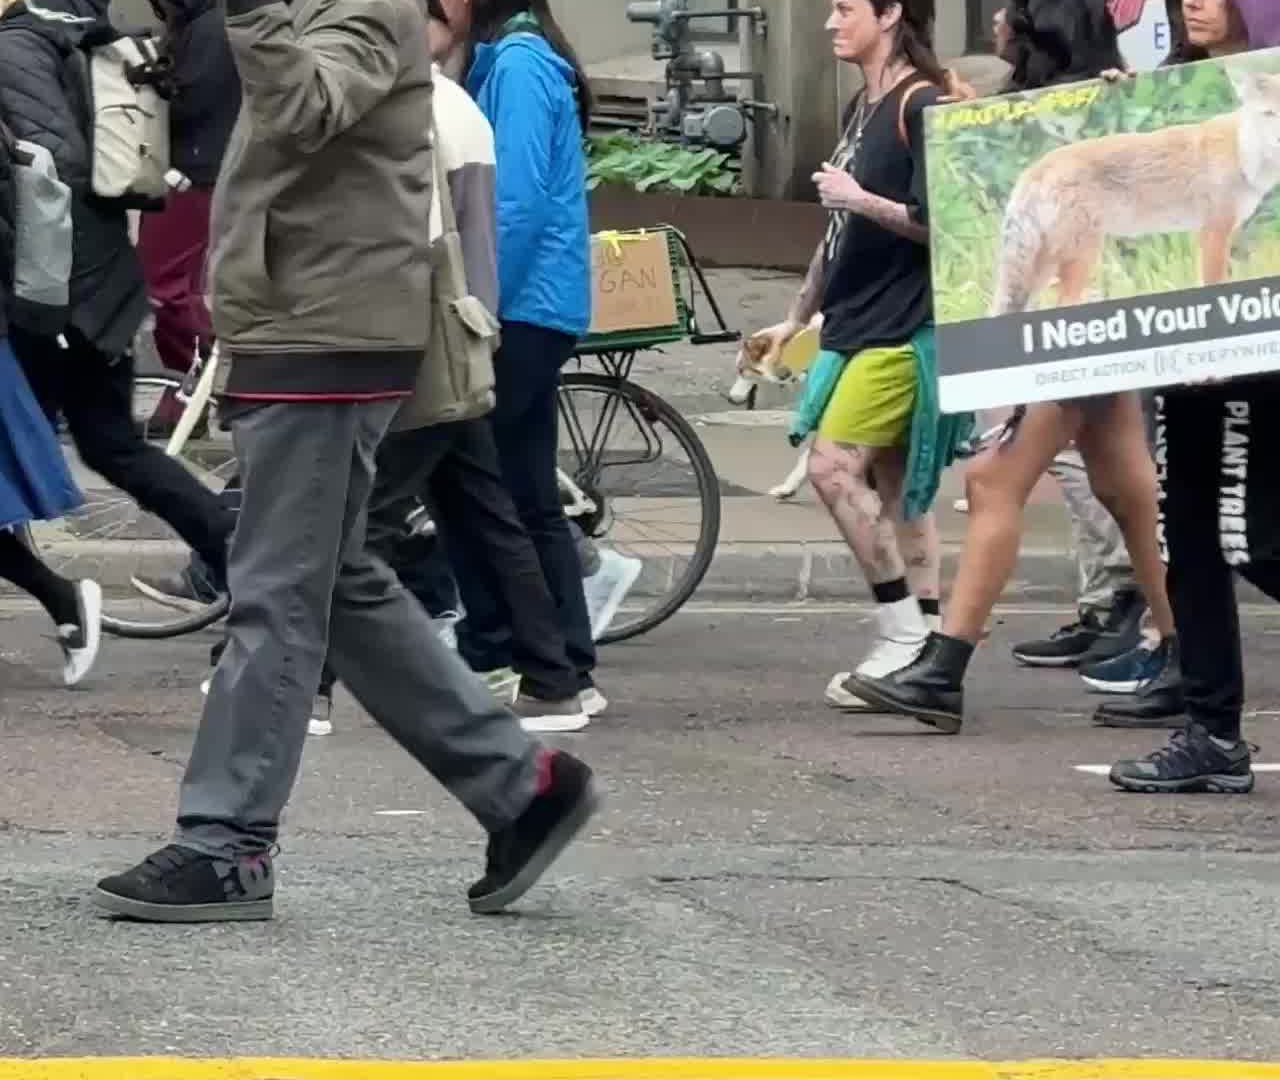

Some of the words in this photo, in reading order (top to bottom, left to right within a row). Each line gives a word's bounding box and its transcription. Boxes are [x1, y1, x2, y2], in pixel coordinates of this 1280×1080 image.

[1023, 323, 1034, 353] I
[1042, 309, 1128, 350] Need
[1133, 303, 1212, 336] Your
[1220, 400, 1251, 479] PLANT
[1218, 482, 1251, 566] TREES
